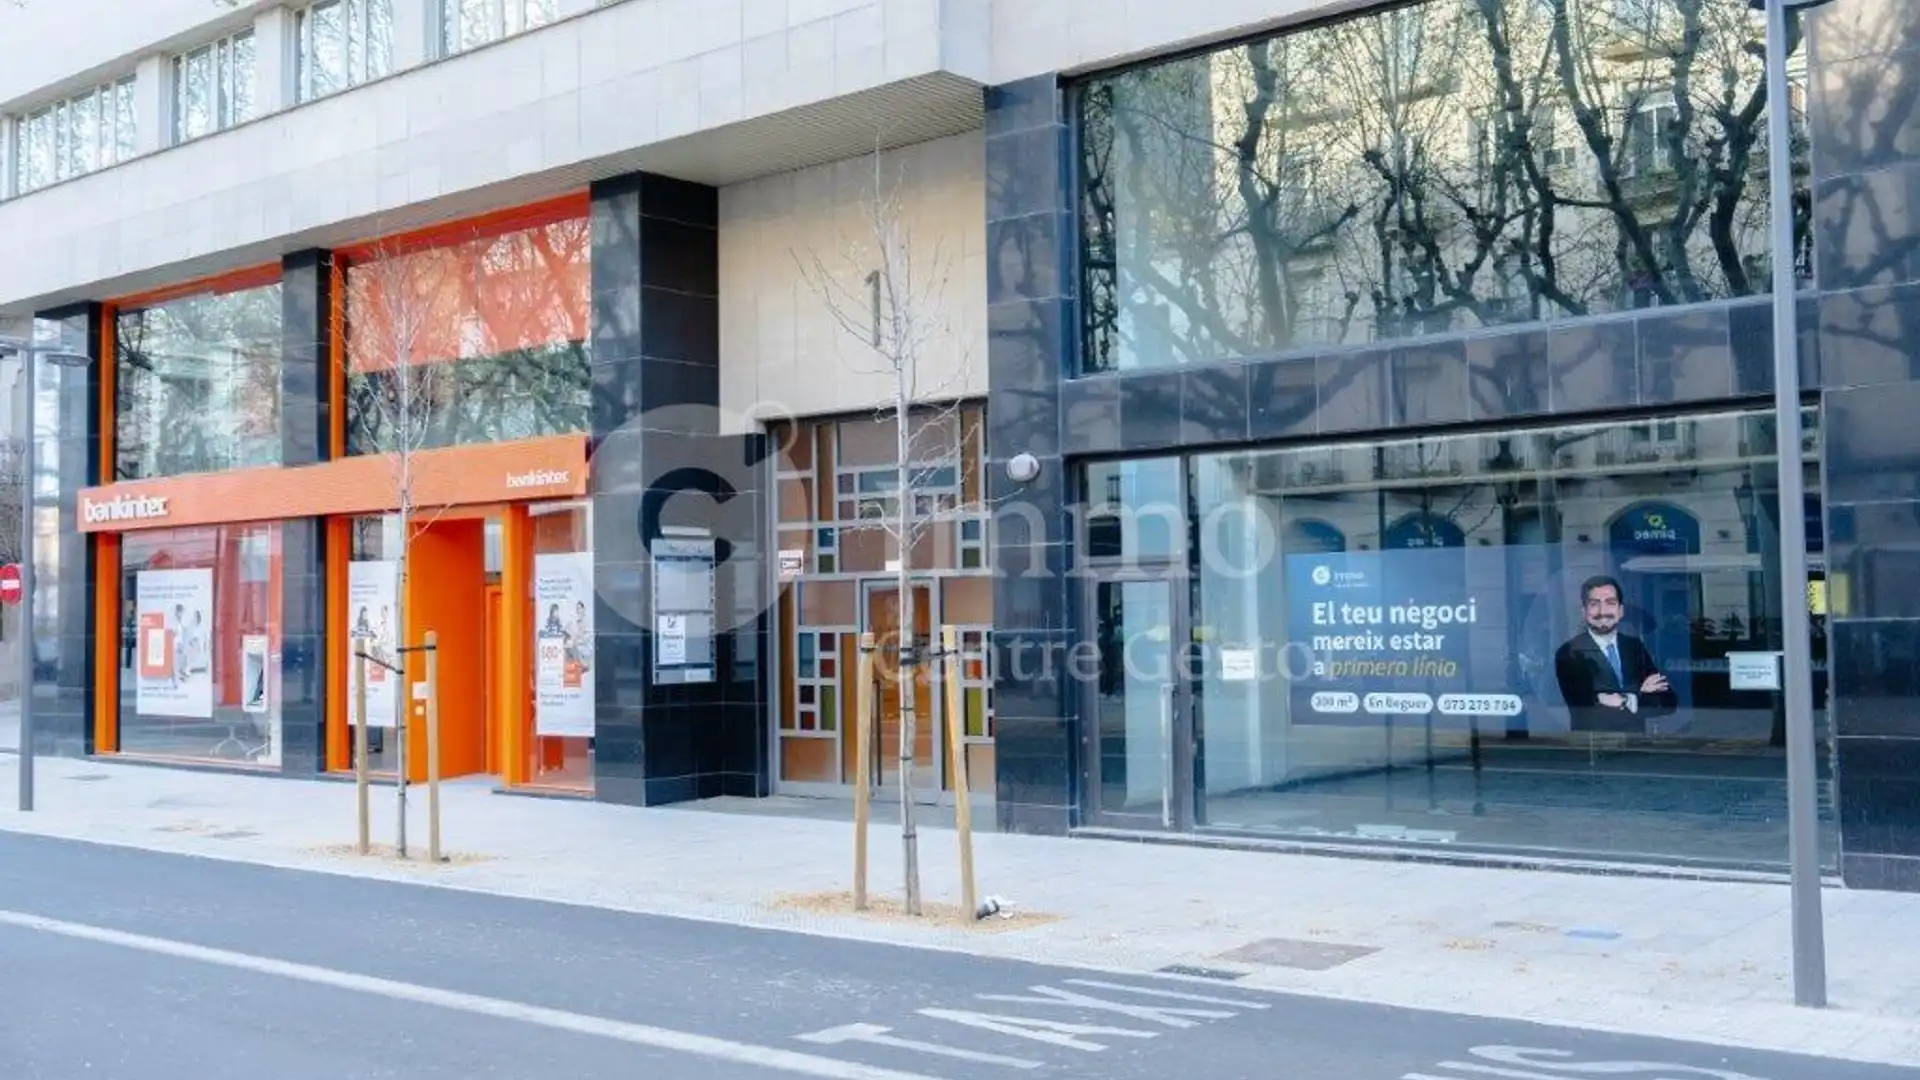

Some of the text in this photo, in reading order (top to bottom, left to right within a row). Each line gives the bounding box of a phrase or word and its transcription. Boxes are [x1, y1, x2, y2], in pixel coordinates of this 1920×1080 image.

[506, 469, 571, 488] bankinter
[84, 494, 169, 523] bankinter
[1312, 601, 1335, 625] El
[1341, 602, 1383, 625] teu
[1313, 630, 1445, 651] mereix estar
[1313, 660, 1325, 676] a
[1367, 696, 1384, 709] En
